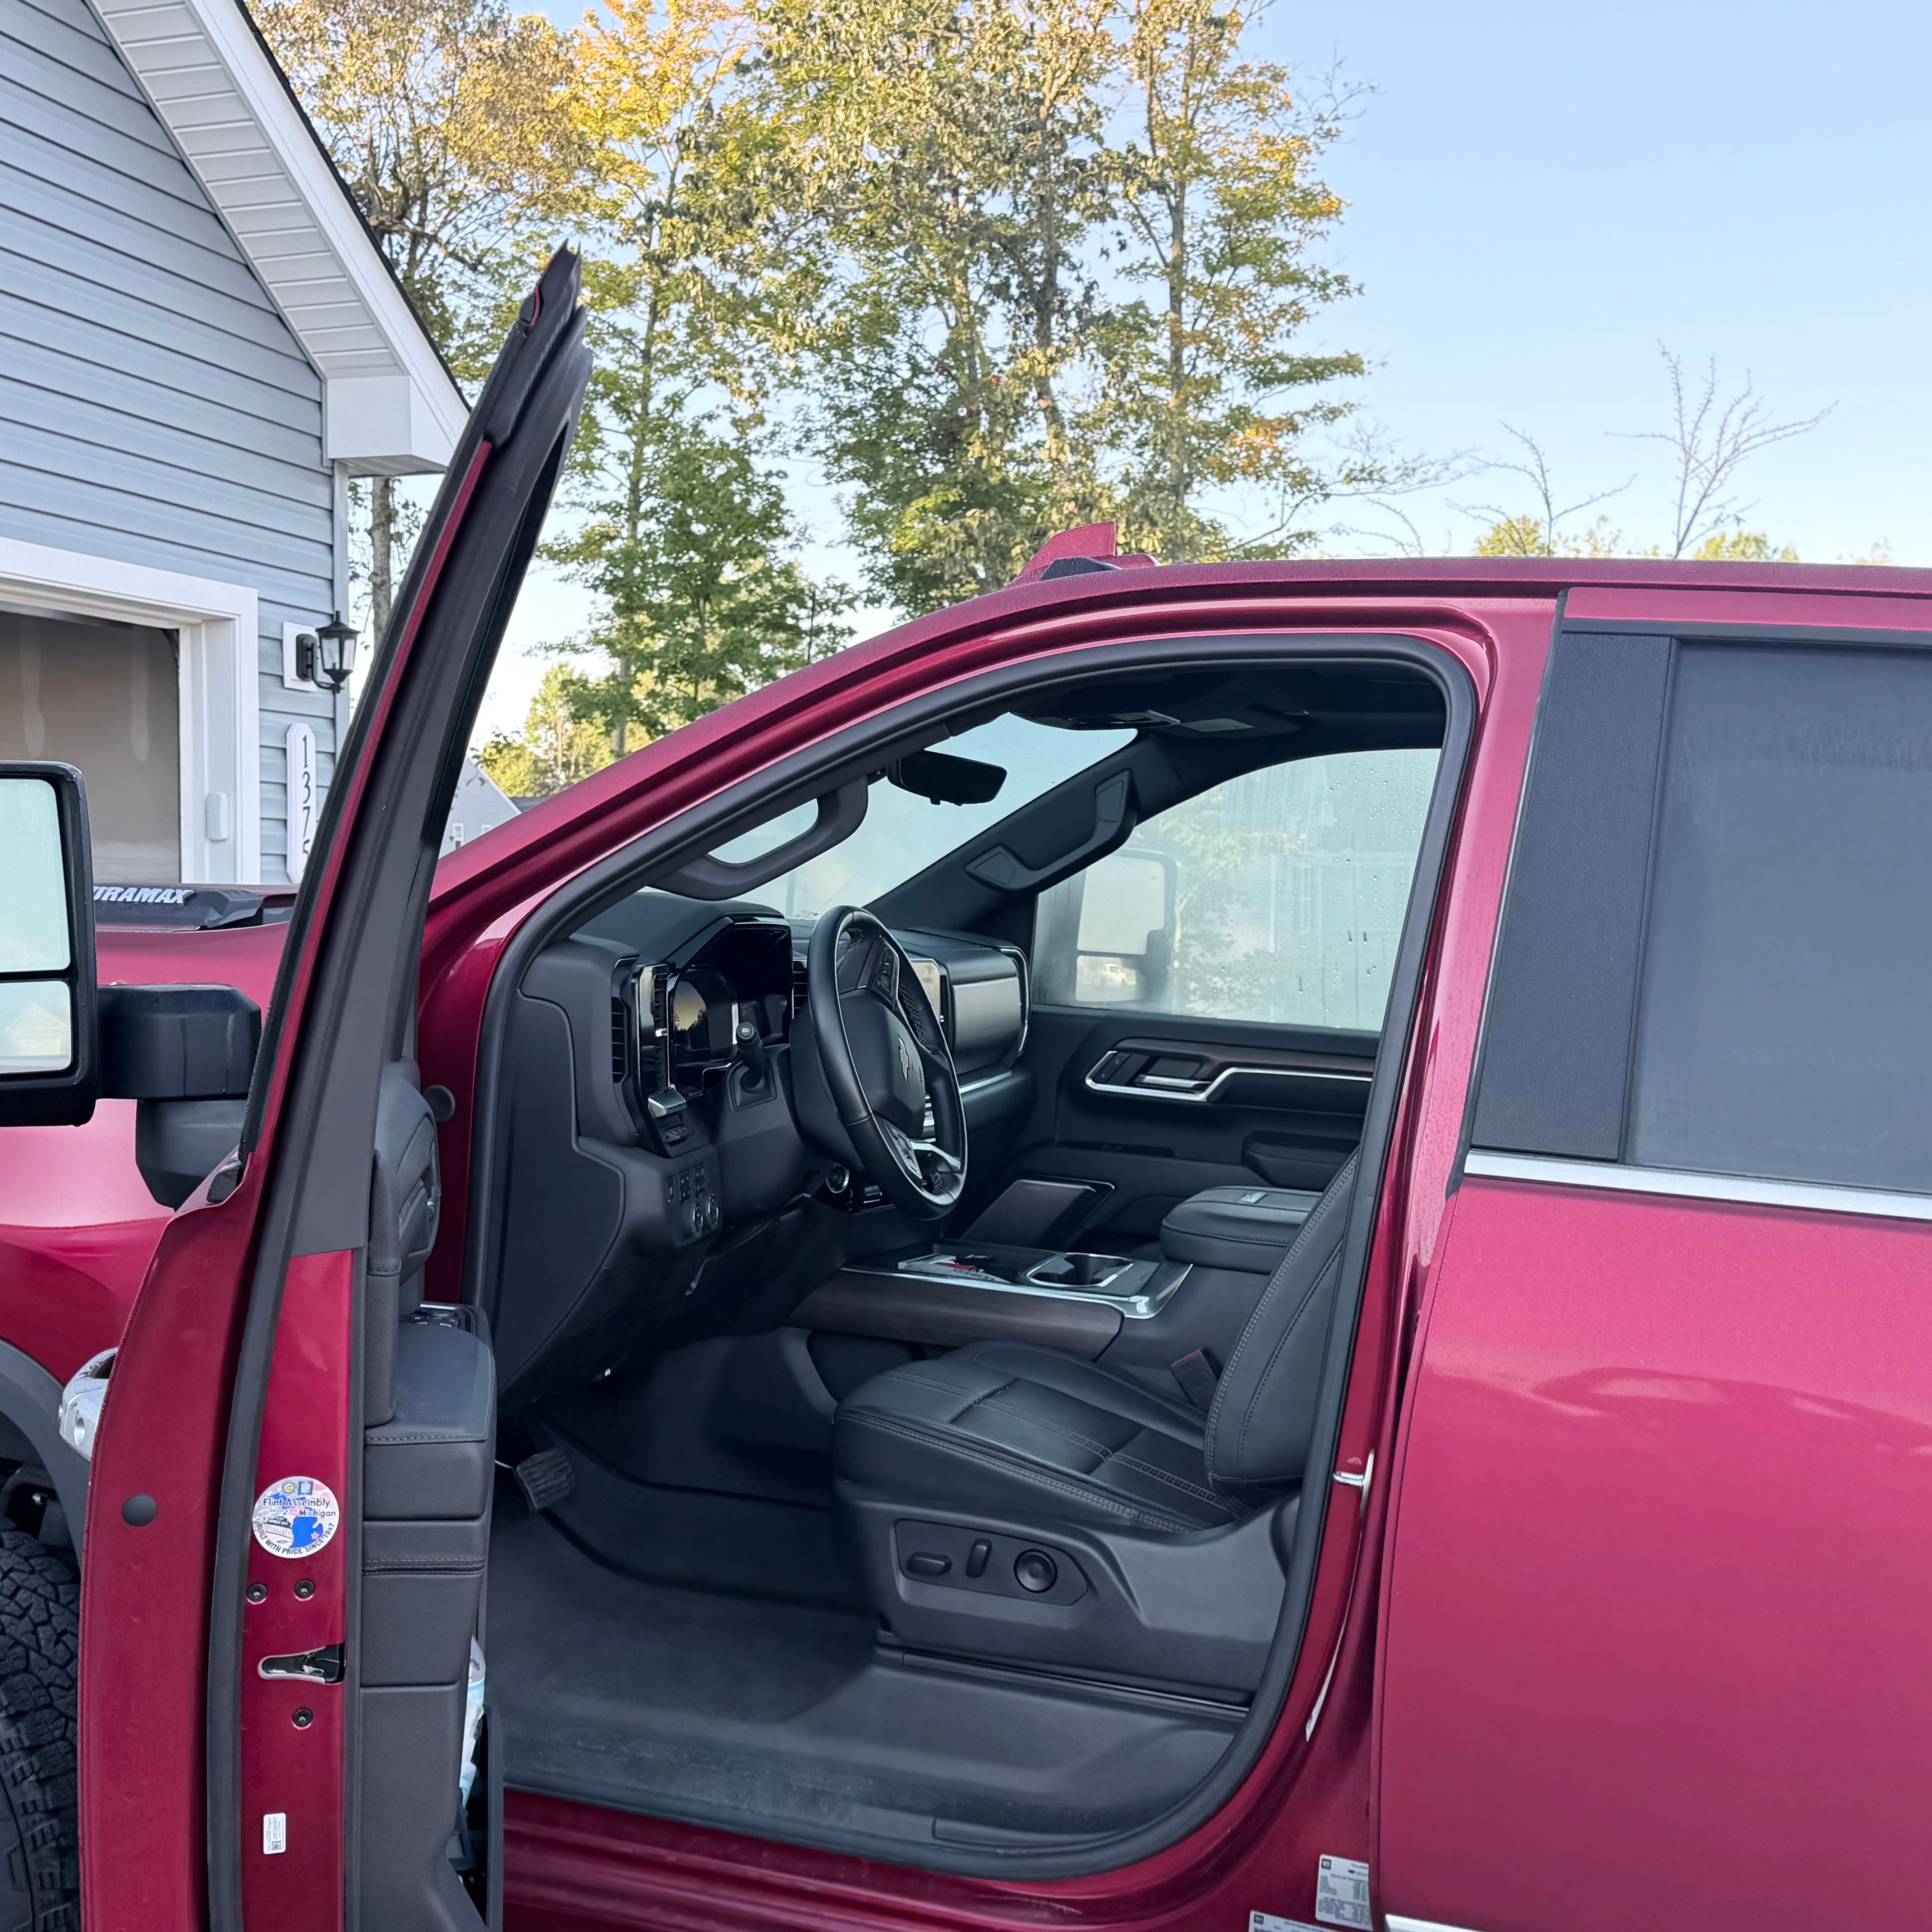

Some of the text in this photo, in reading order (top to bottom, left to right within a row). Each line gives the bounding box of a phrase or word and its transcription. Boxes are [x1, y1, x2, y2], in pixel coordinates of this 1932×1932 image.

[93, 886, 194, 904] URAMAX
[263, 1498, 331, 1508] Flint Assembly
[299, 1509, 336, 1518] Michigan
[257, 1523, 267, 1540] BUILT
[265, 1539, 281, 1552] WITH
[305, 1538, 324, 1552] SINCE
[323, 1523, 335, 1538] 1947
